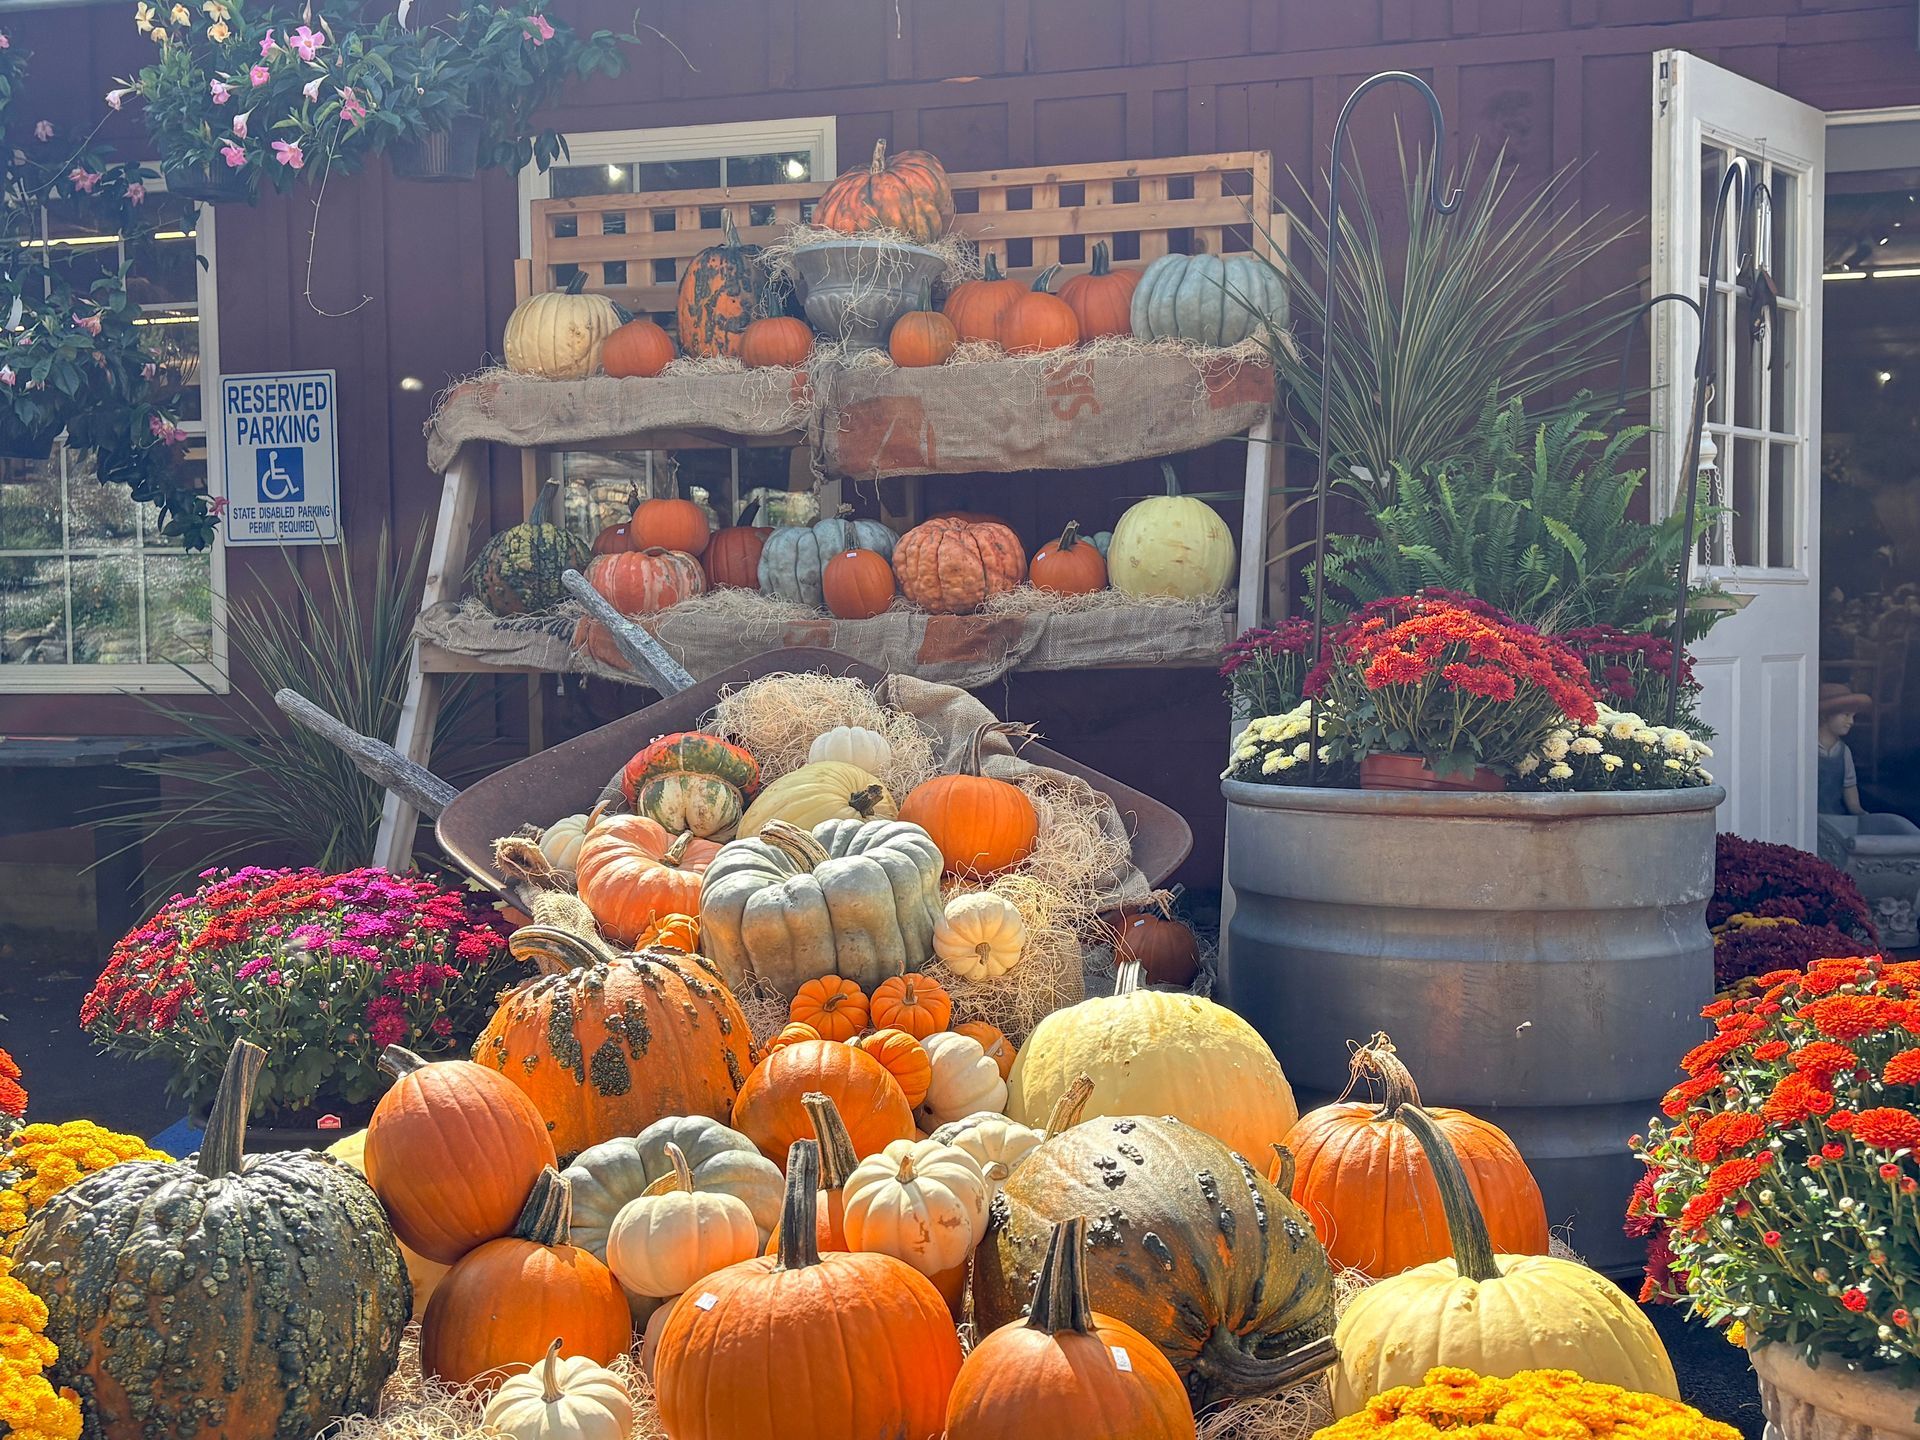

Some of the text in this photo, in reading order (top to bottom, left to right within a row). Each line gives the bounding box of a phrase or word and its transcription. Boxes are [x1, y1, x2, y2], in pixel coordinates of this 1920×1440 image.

[227, 381, 328, 415] RESERVED
[236, 413, 321, 446] PARKING
[233, 505, 331, 520] STATE DISABLED PARKING
[249, 520, 315, 534] PERMIT REQUIRED
